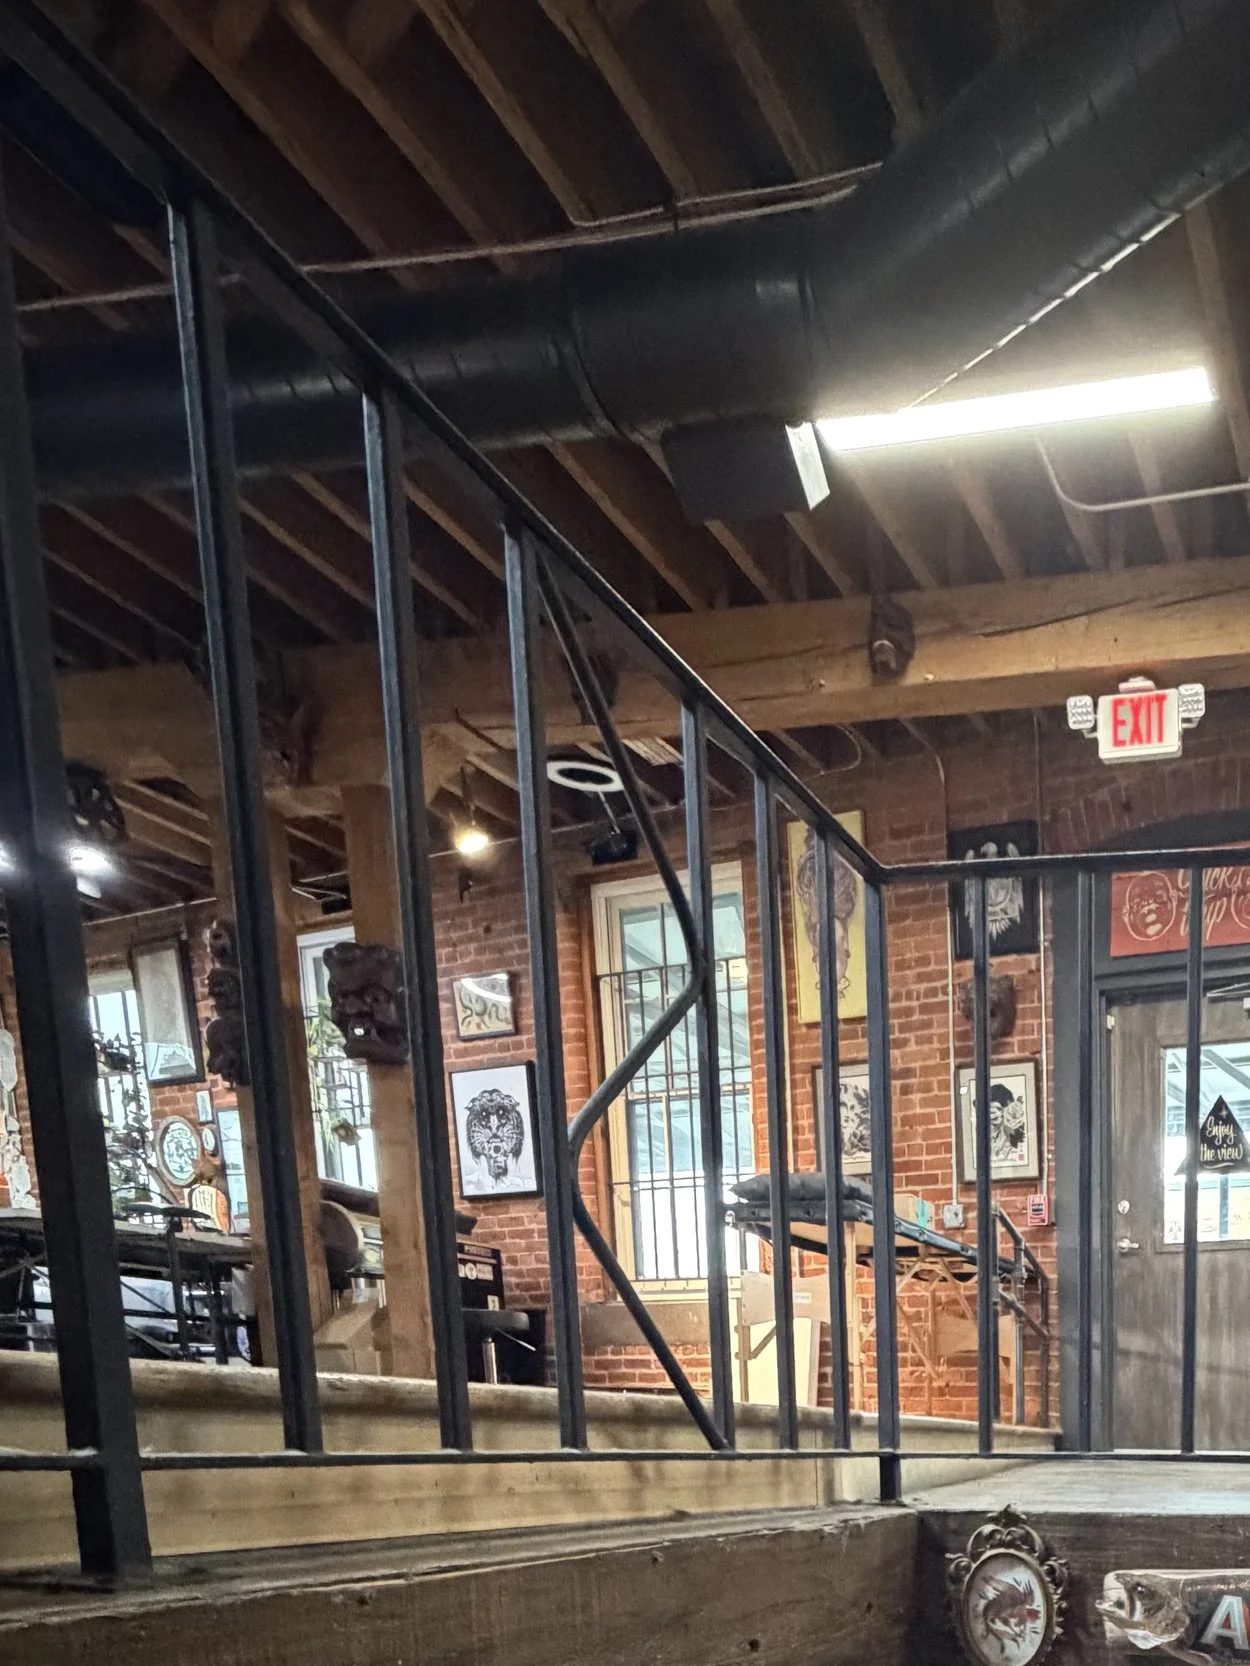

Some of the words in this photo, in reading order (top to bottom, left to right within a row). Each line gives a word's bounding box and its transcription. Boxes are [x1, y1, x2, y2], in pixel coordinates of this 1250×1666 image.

[1111, 693, 1167, 747] EXIT
[1205, 1116, 1237, 1146] Enjoy
[1200, 1143, 1216, 1161] the
[1217, 1143, 1244, 1161] view
